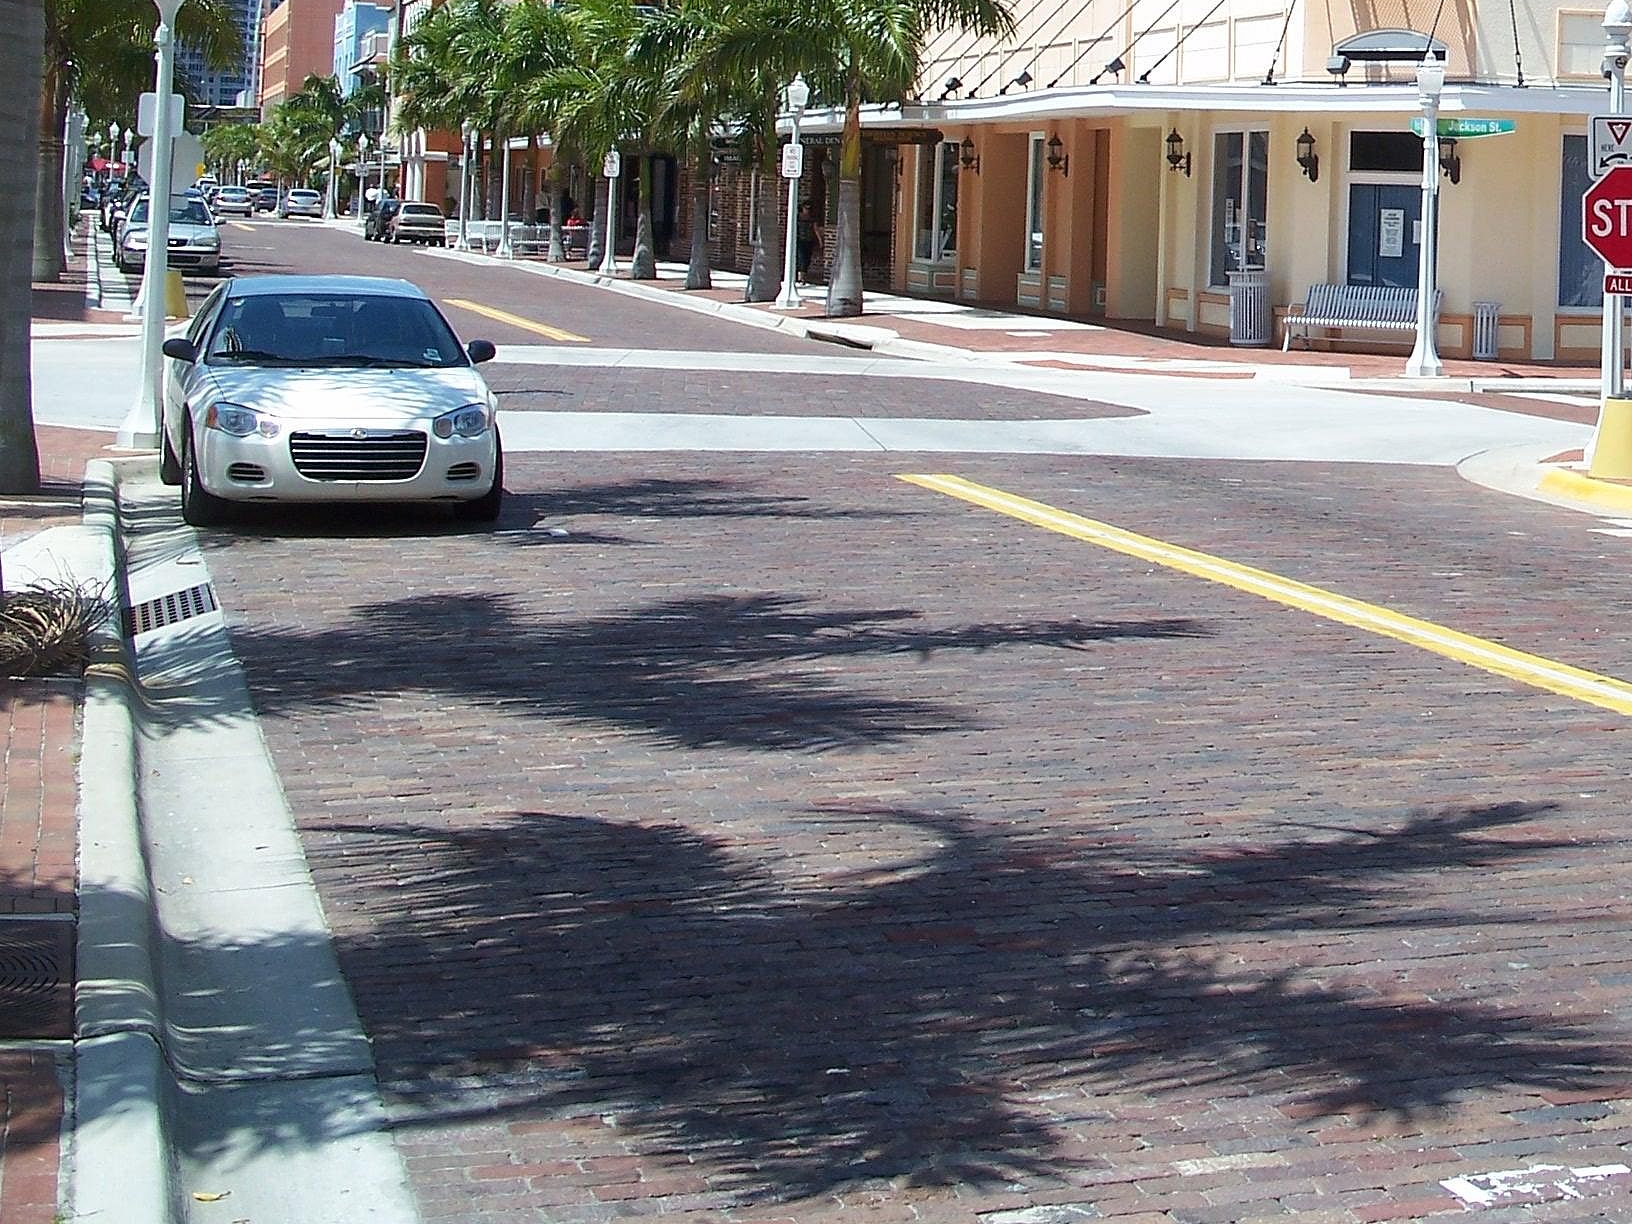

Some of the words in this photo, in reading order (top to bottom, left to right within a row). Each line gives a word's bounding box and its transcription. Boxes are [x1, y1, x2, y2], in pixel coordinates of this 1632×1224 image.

[1448, 120, 1487, 132] Jackson
[800, 137, 824, 145] NERAL
[825, 137, 842, 145] DEN
[1609, 278, 1632, 292] ALL
